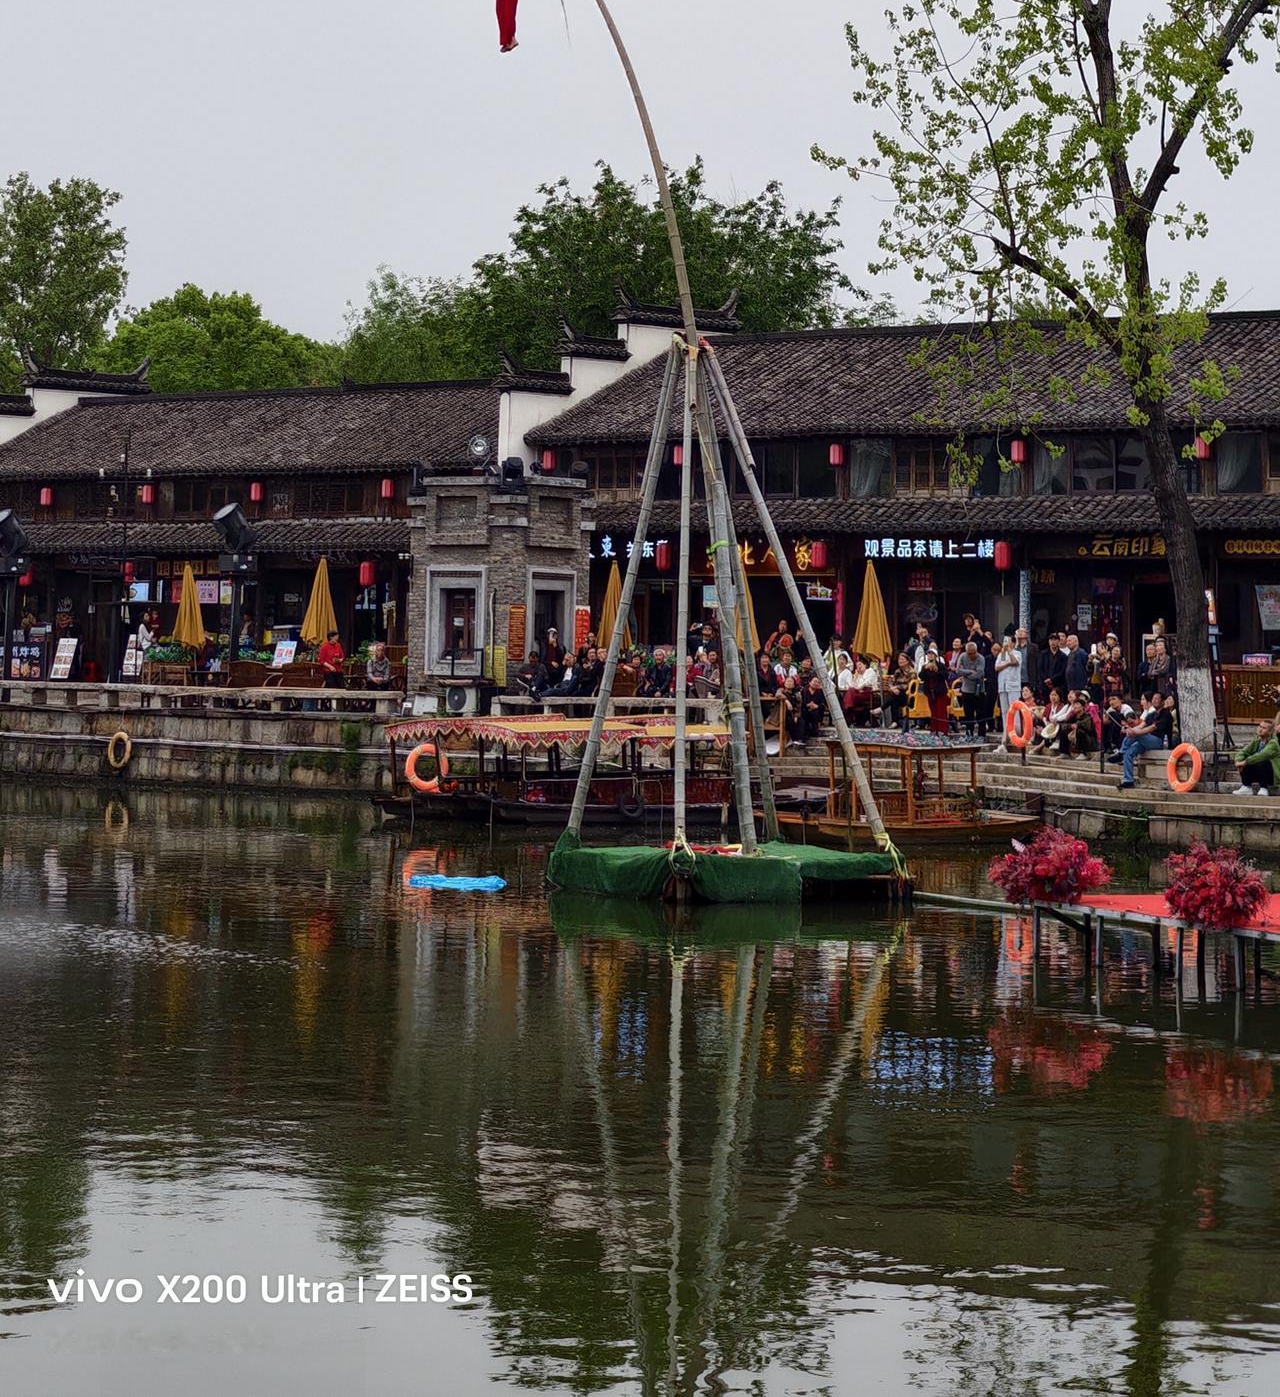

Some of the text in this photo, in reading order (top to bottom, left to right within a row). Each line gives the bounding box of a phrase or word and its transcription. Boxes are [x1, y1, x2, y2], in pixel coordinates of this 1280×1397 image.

[864, 539, 994, 558] 观景品茶请上二楼
